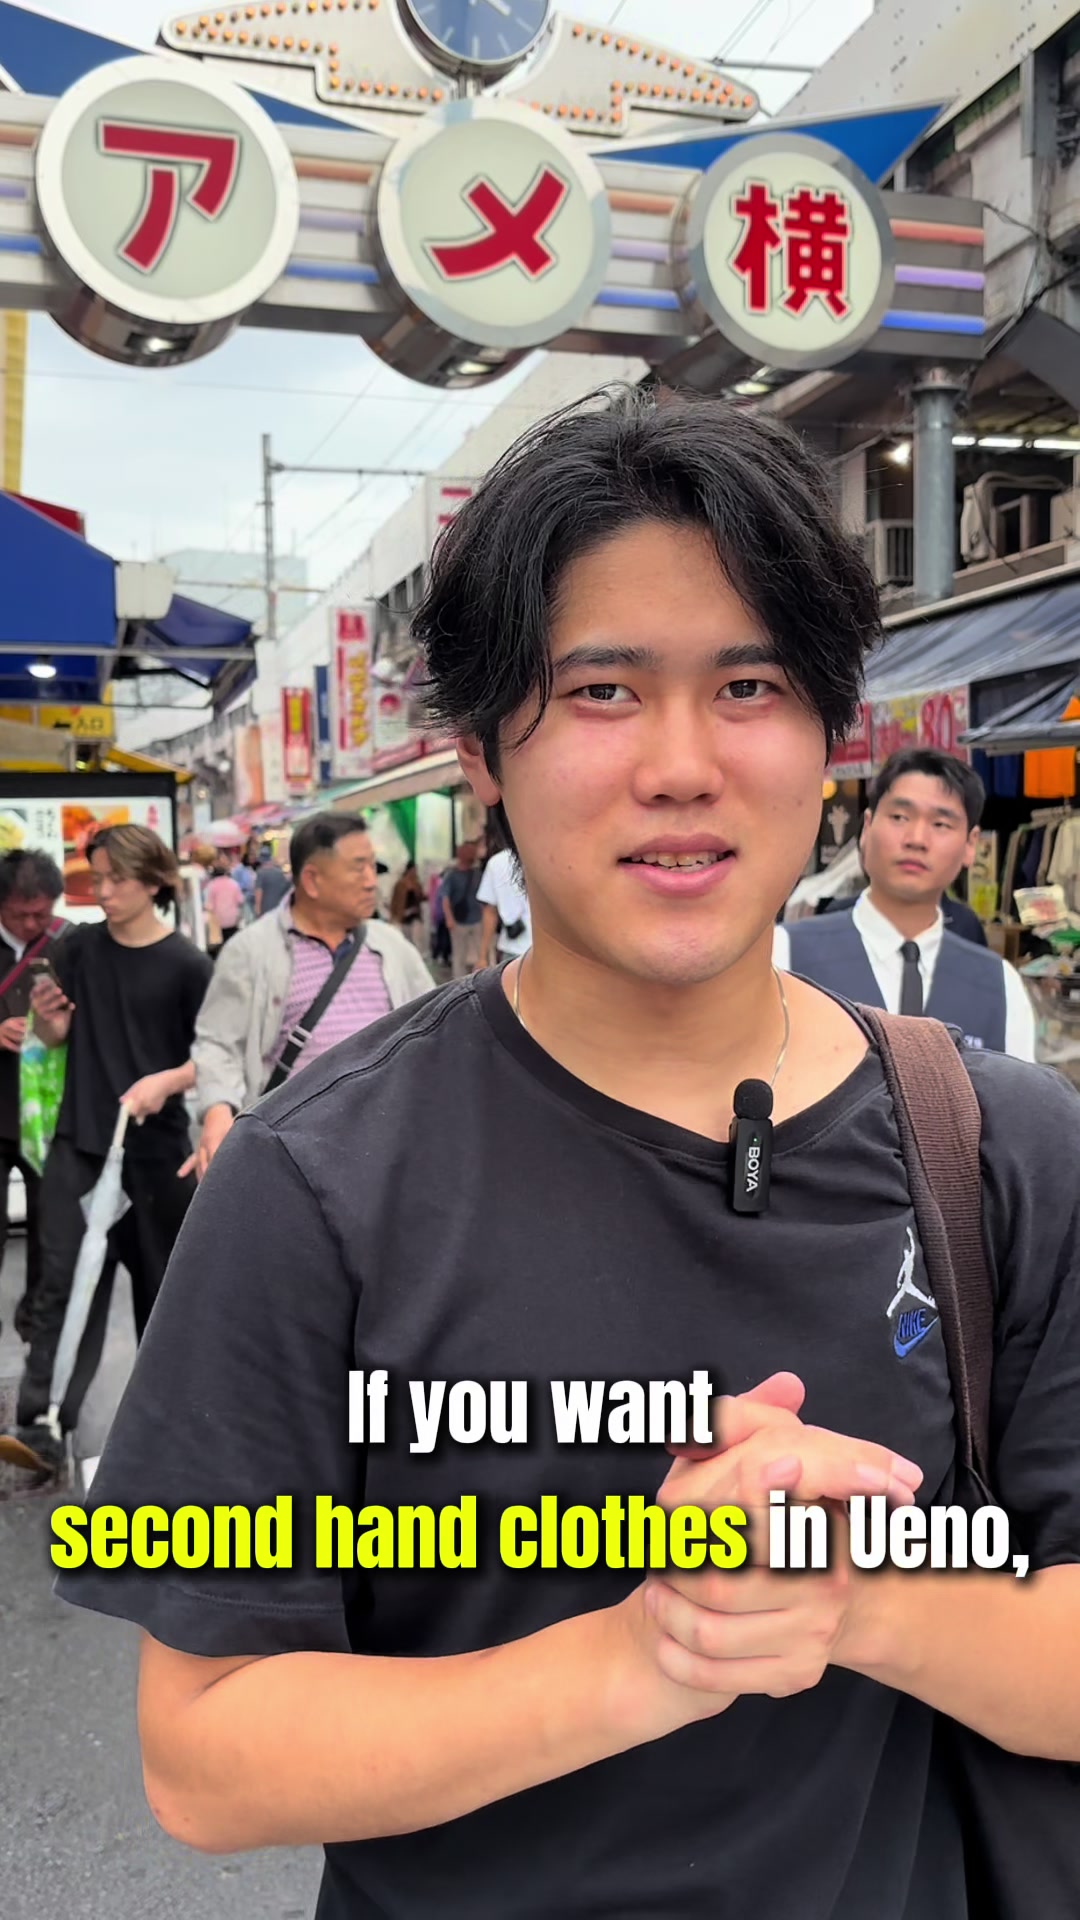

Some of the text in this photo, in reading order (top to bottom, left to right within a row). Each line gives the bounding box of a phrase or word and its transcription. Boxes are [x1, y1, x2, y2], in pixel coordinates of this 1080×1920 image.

[97, 118, 850, 319] アメ横
[746, 1146, 760, 1192] BOYA
[899, 1307, 927, 1339] NIKE
